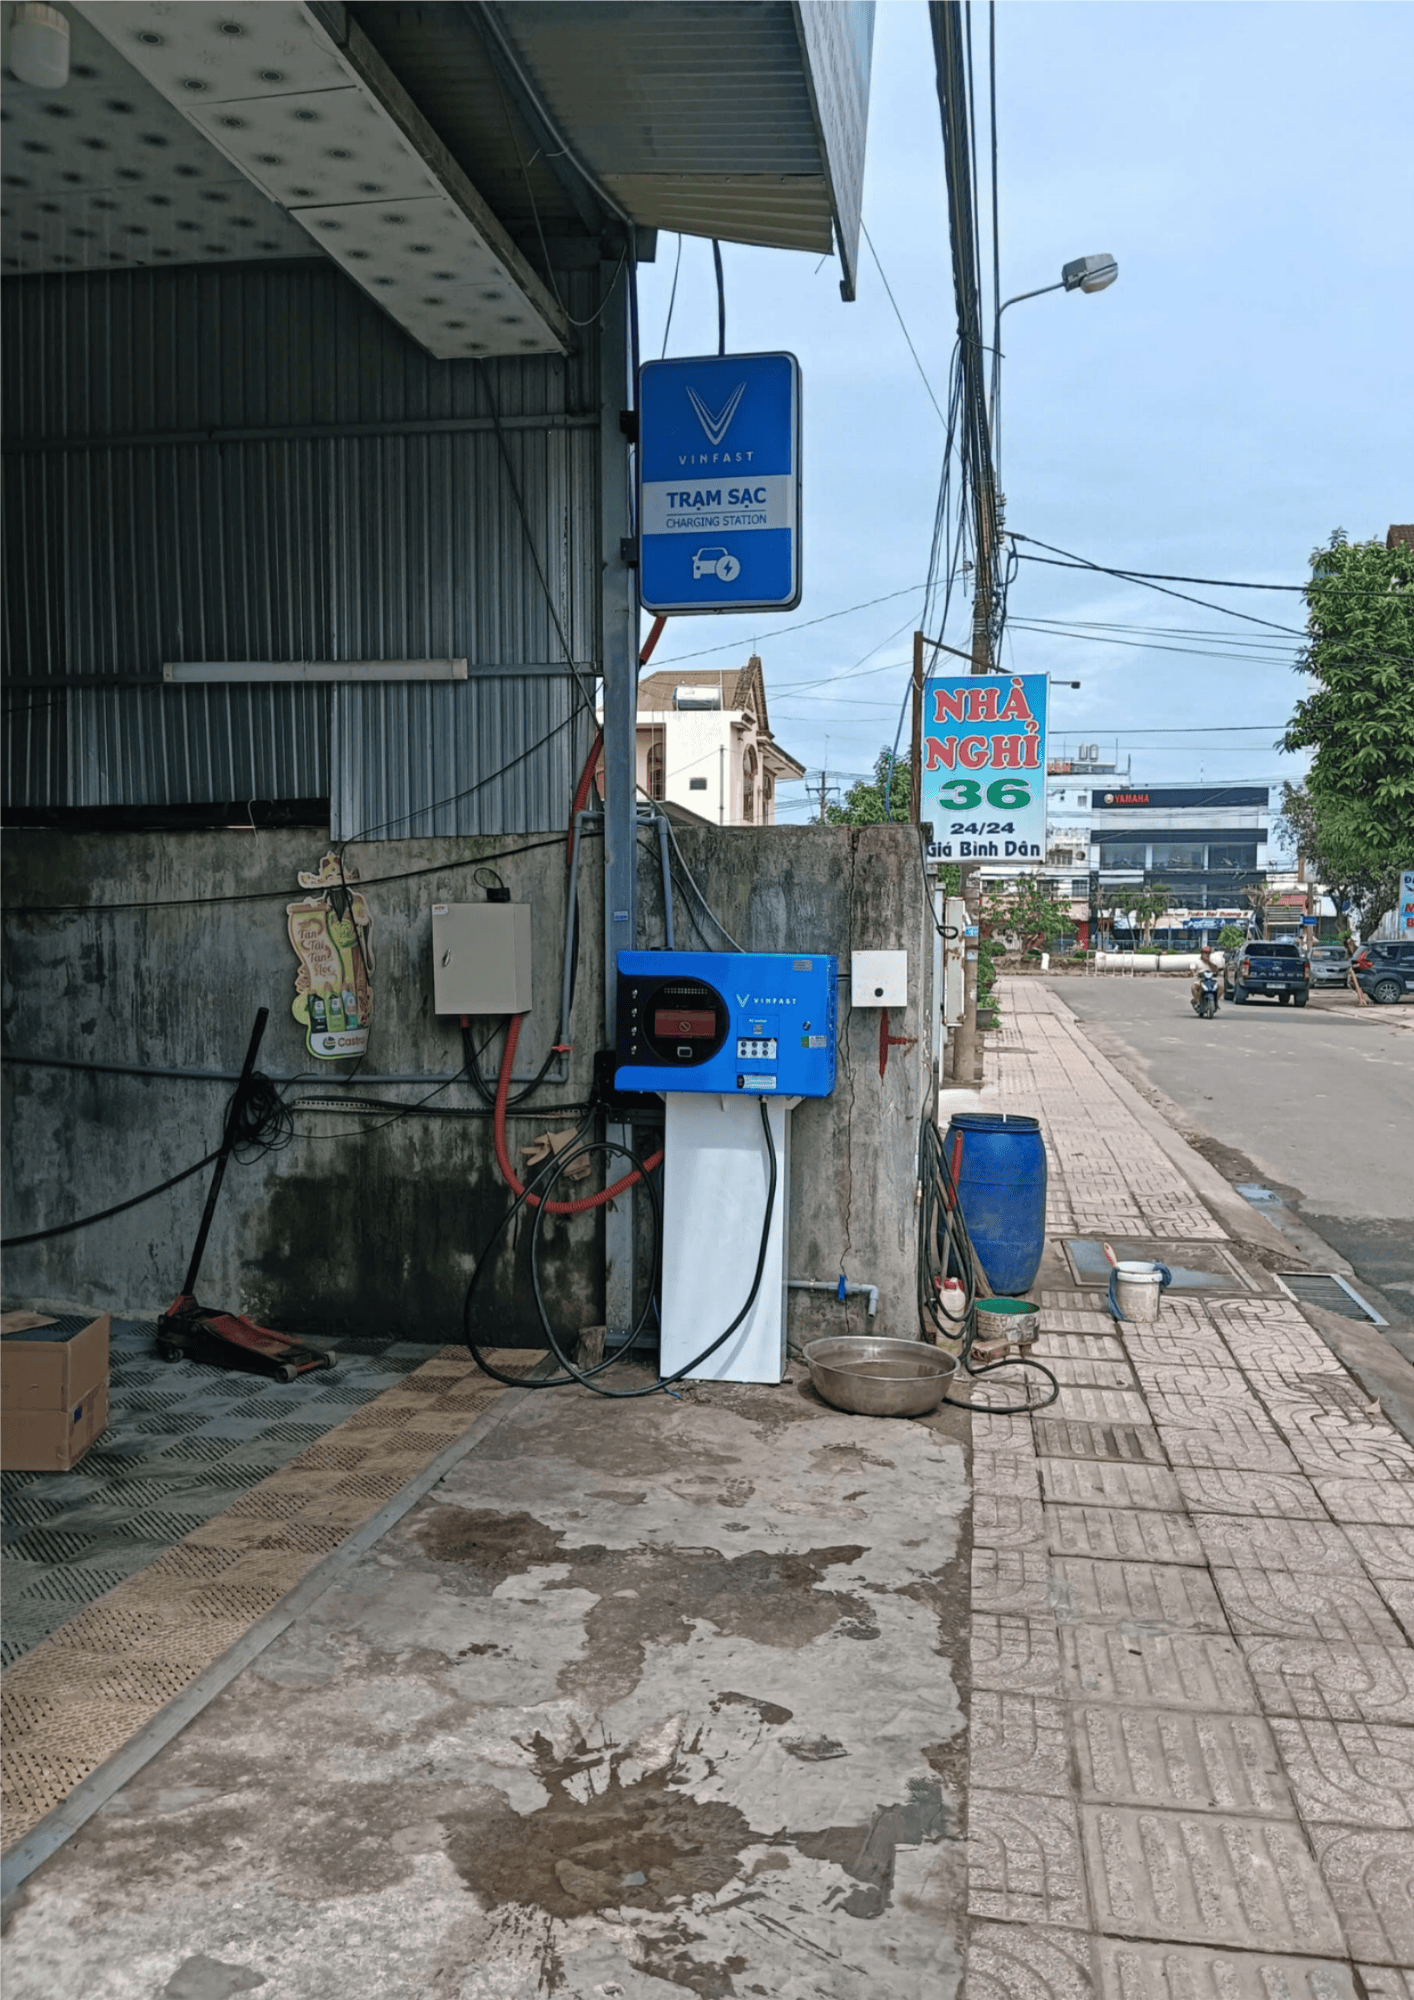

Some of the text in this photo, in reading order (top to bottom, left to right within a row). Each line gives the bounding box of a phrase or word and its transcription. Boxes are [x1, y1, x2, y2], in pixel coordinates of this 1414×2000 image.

[678, 451, 754, 465] VINFAST
[666, 487, 767, 511] TRẠM SẠC
[666, 514, 767, 529] CHARGING STATION
[933, 677, 1034, 723] NHÀ
[925, 720, 1041, 771] NGHỈ
[938, 777, 1033, 812] 36
[1114, 794, 1150, 804] YAMAHA
[950, 822, 1015, 836] 24/24
[926, 840, 1041, 857] Giá Bình Dân
